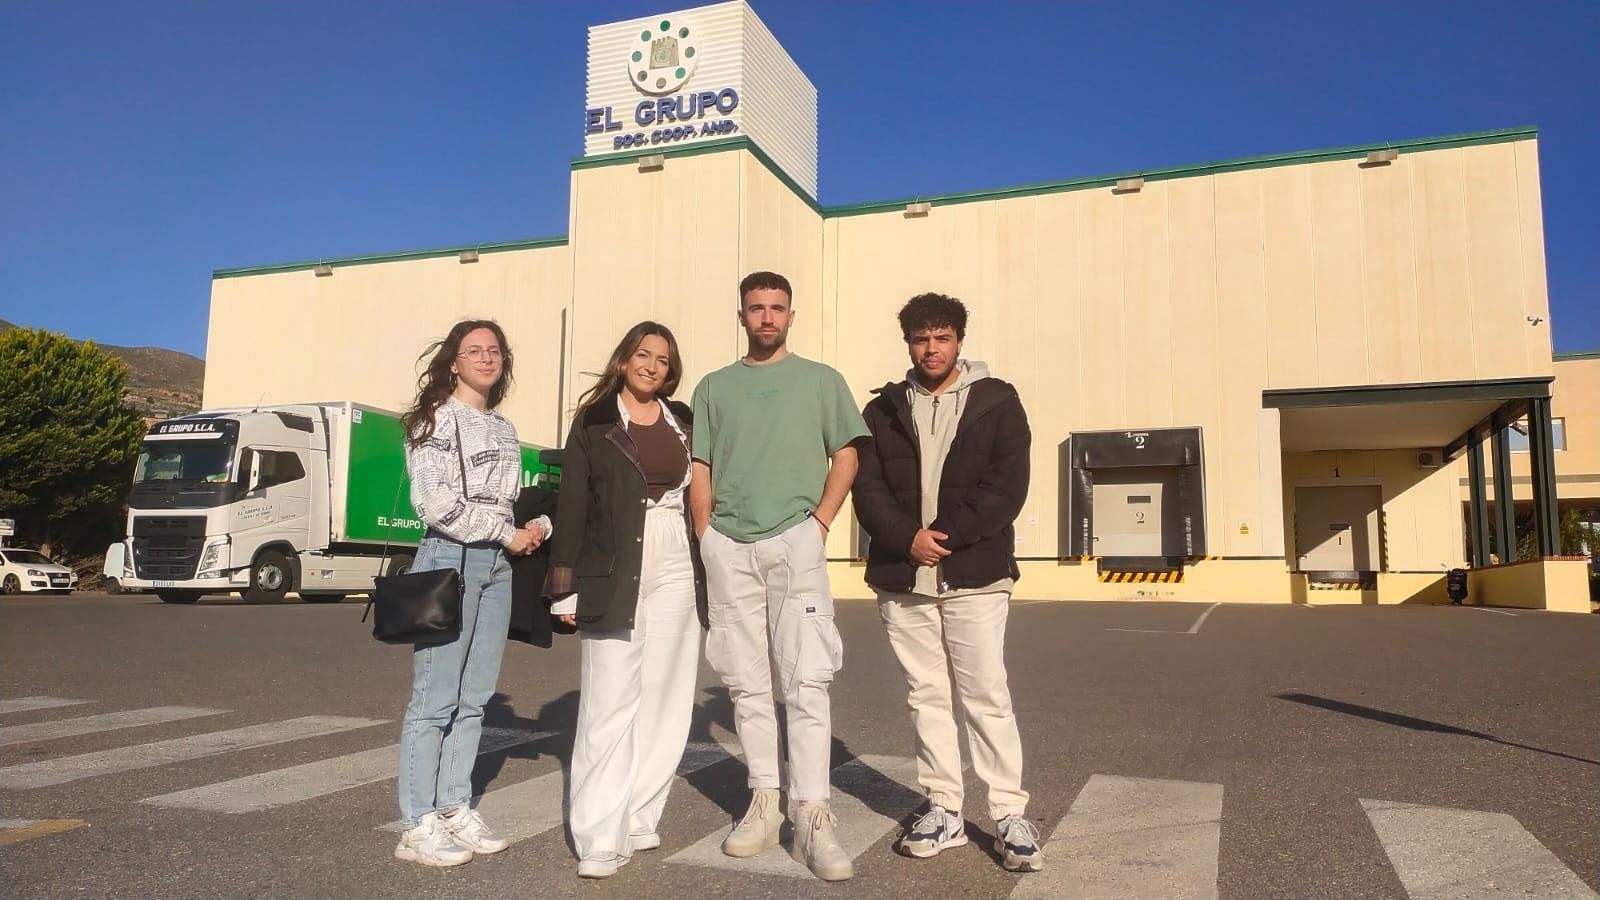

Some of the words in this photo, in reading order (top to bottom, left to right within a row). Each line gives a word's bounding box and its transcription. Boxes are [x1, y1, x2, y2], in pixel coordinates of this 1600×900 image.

[586, 106, 623, 133] EL
[634, 87, 739, 126] GRUPO
[160, 425, 168, 433] EL
[168, 424, 194, 432] GRUPO
[1135, 436, 1145, 449] 2
[377, 516, 390, 527] EL
[391, 518, 421, 529] GRUPO
[1135, 511, 1145, 524] 2
